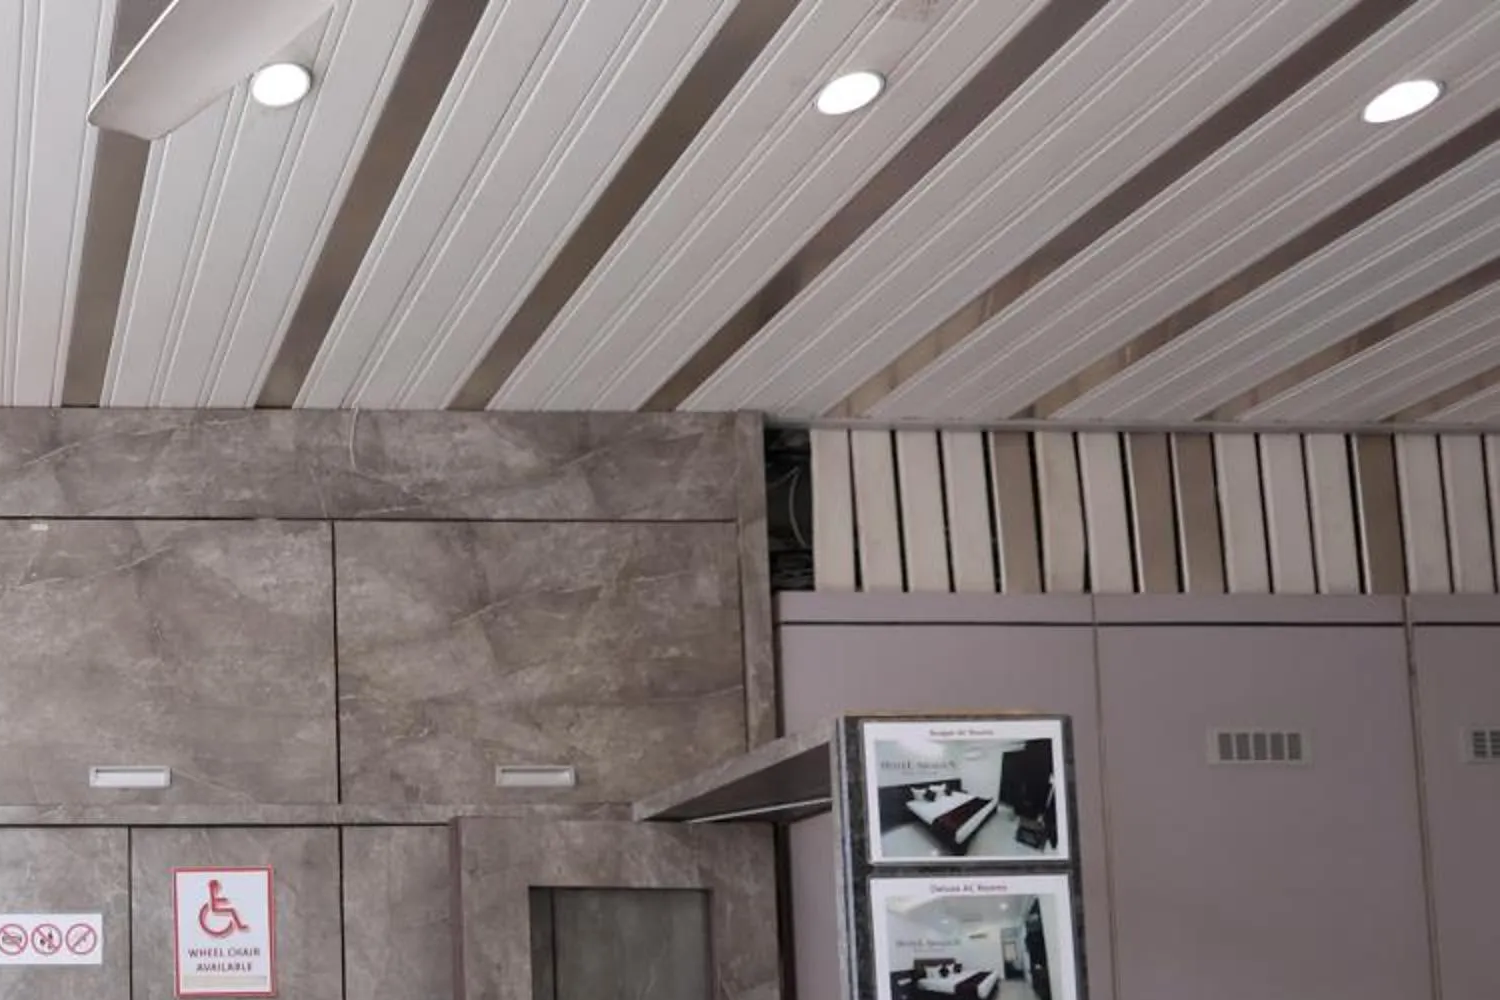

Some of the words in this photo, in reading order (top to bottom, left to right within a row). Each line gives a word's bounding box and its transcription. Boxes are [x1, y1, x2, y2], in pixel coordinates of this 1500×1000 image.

[188, 948, 223, 957] WHEEL
[227, 948, 261, 957] CHAIR
[196, 963, 252, 972] AVAILABLE
